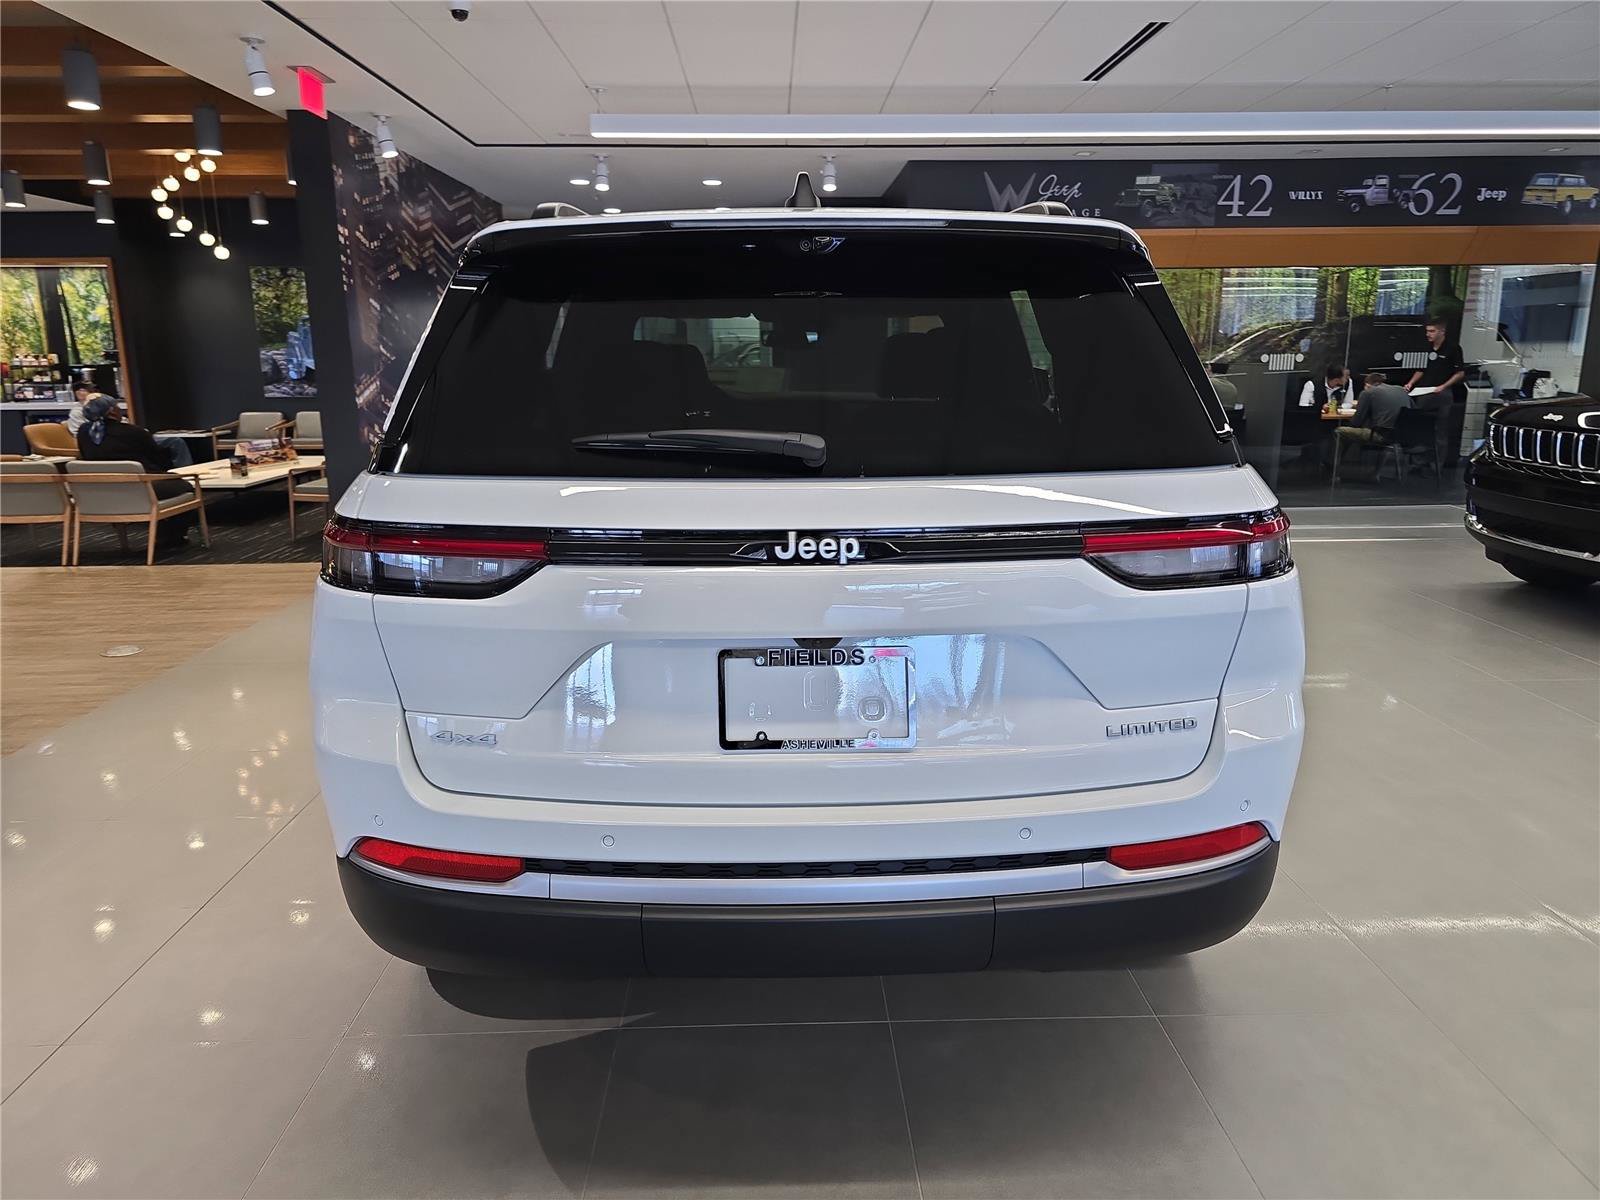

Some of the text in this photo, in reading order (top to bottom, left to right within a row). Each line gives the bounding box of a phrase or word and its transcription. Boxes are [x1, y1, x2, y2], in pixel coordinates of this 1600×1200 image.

[1038, 174, 1083, 203] Jeep
[1216, 174, 1274, 217] 42
[1408, 172, 1463, 216] 62
[1476, 187, 1508, 202] Jeep
[774, 531, 861, 565] Jeep
[767, 648, 866, 667] FIELDS
[1106, 717, 1198, 738] LIMITED
[781, 739, 856, 750] ASHEVILLE
